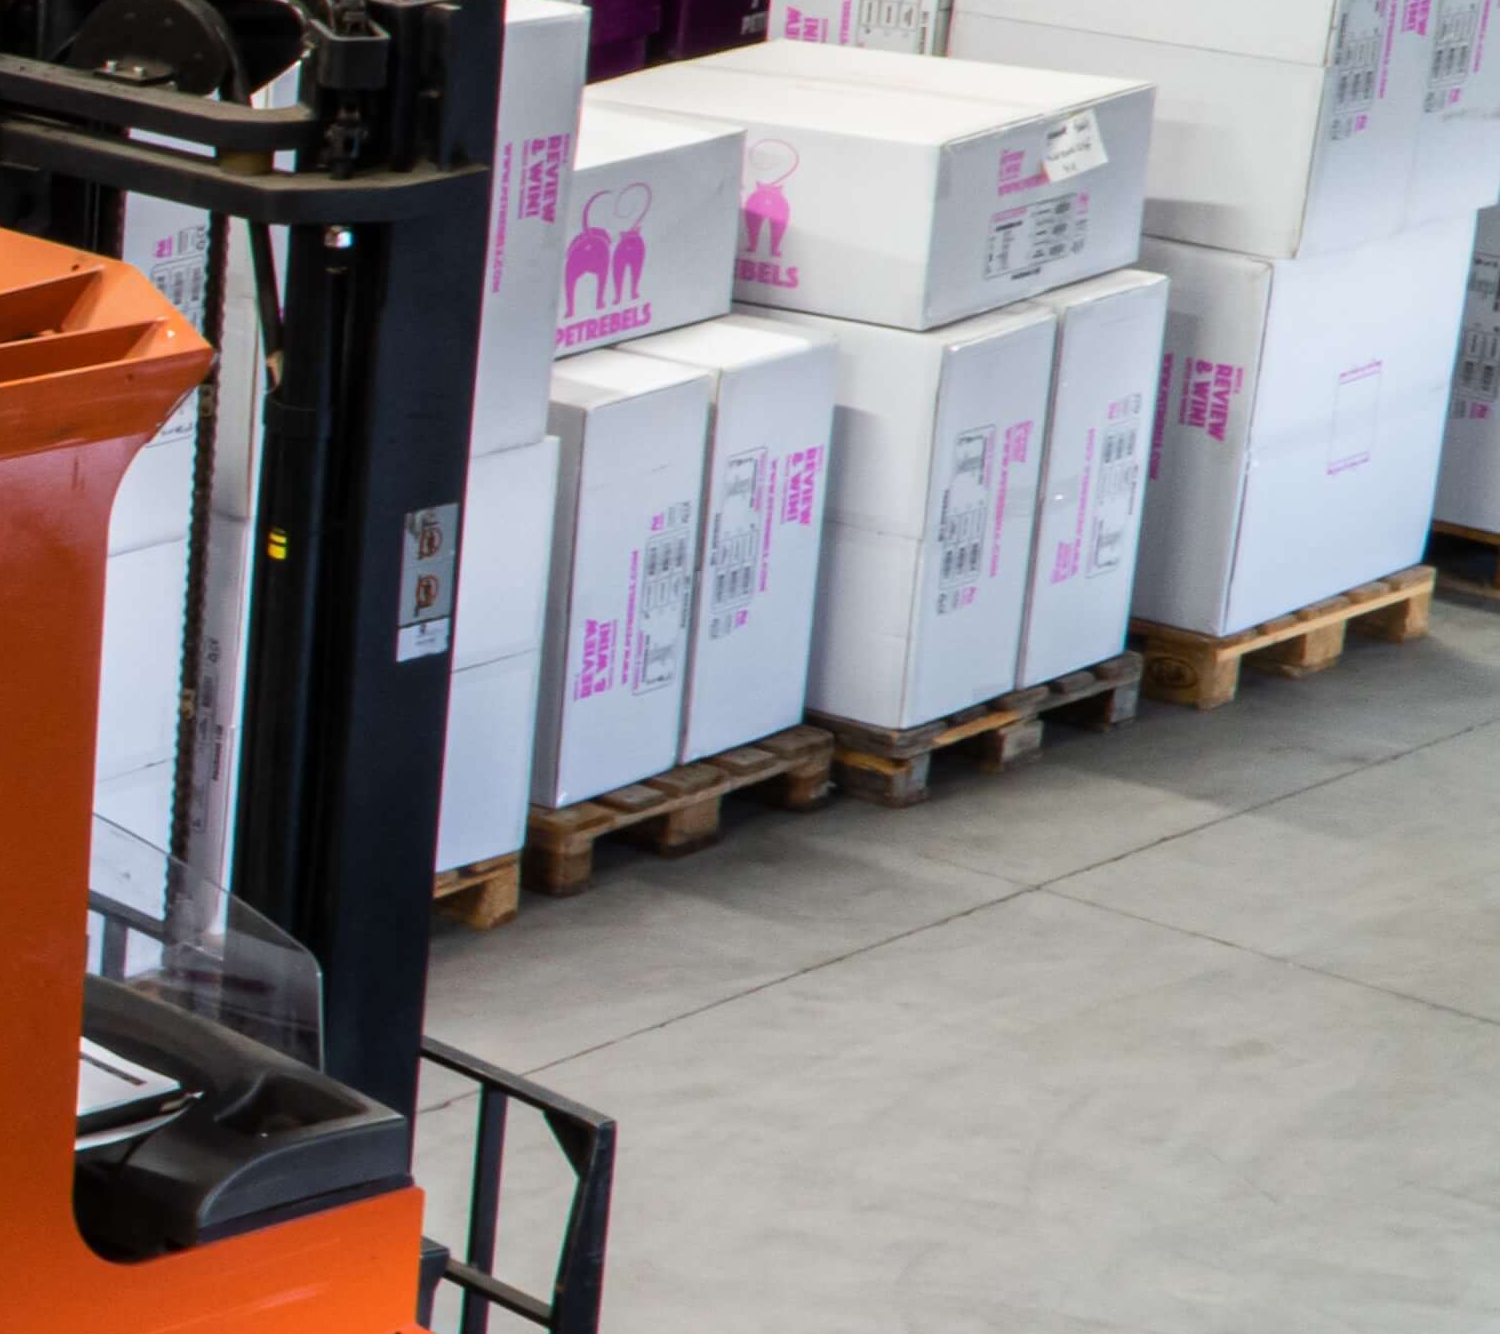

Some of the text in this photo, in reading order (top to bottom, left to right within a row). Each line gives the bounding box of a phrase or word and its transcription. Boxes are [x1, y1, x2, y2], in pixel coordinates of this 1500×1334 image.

[541, 135, 569, 223] REVIEW
[556, 303, 652, 346] PETREBELS
[1209, 364, 1233, 439] REVIEW
